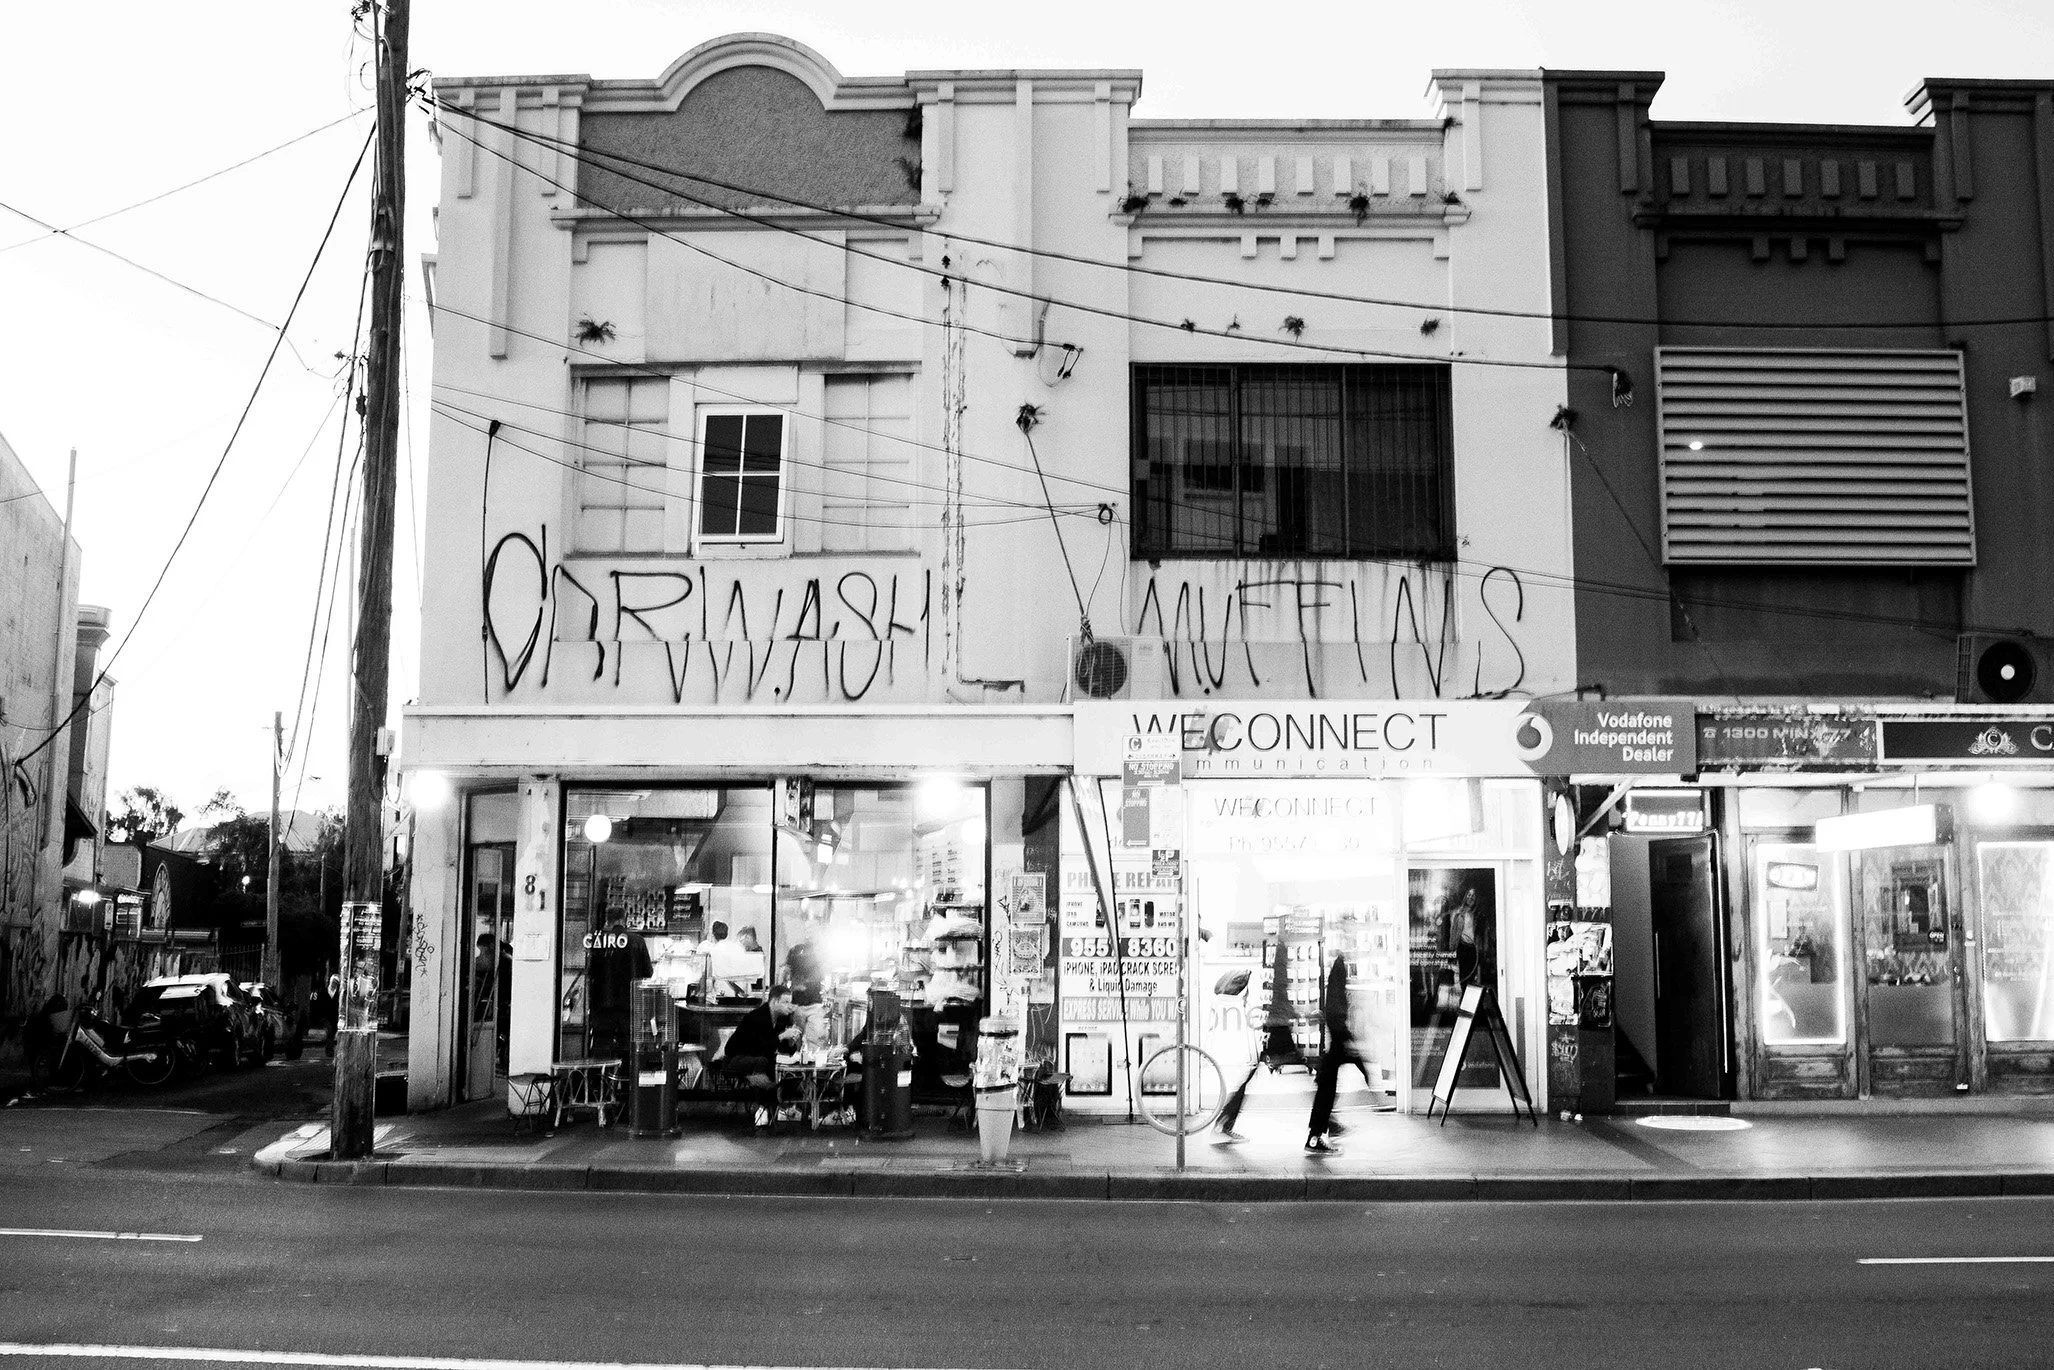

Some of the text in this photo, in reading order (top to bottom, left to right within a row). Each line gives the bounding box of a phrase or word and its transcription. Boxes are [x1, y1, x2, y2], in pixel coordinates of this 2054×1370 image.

[1598, 712, 1672, 728] Vodafone
[1132, 712, 1448, 751] WECONNECT
[1574, 729, 1674, 747] Independent
[1722, 727, 1769, 739] 1300
[2030, 725, 2054, 751] C
[1197, 756, 1433, 770] mmunication
[1622, 746, 1674, 762] Dealer
[1214, 797, 1378, 818] WECONNECT
[1128, 937, 1177, 957] 8360
[1121, 962, 1149, 976] CRACK
[1125, 979, 1158, 998] Damage
